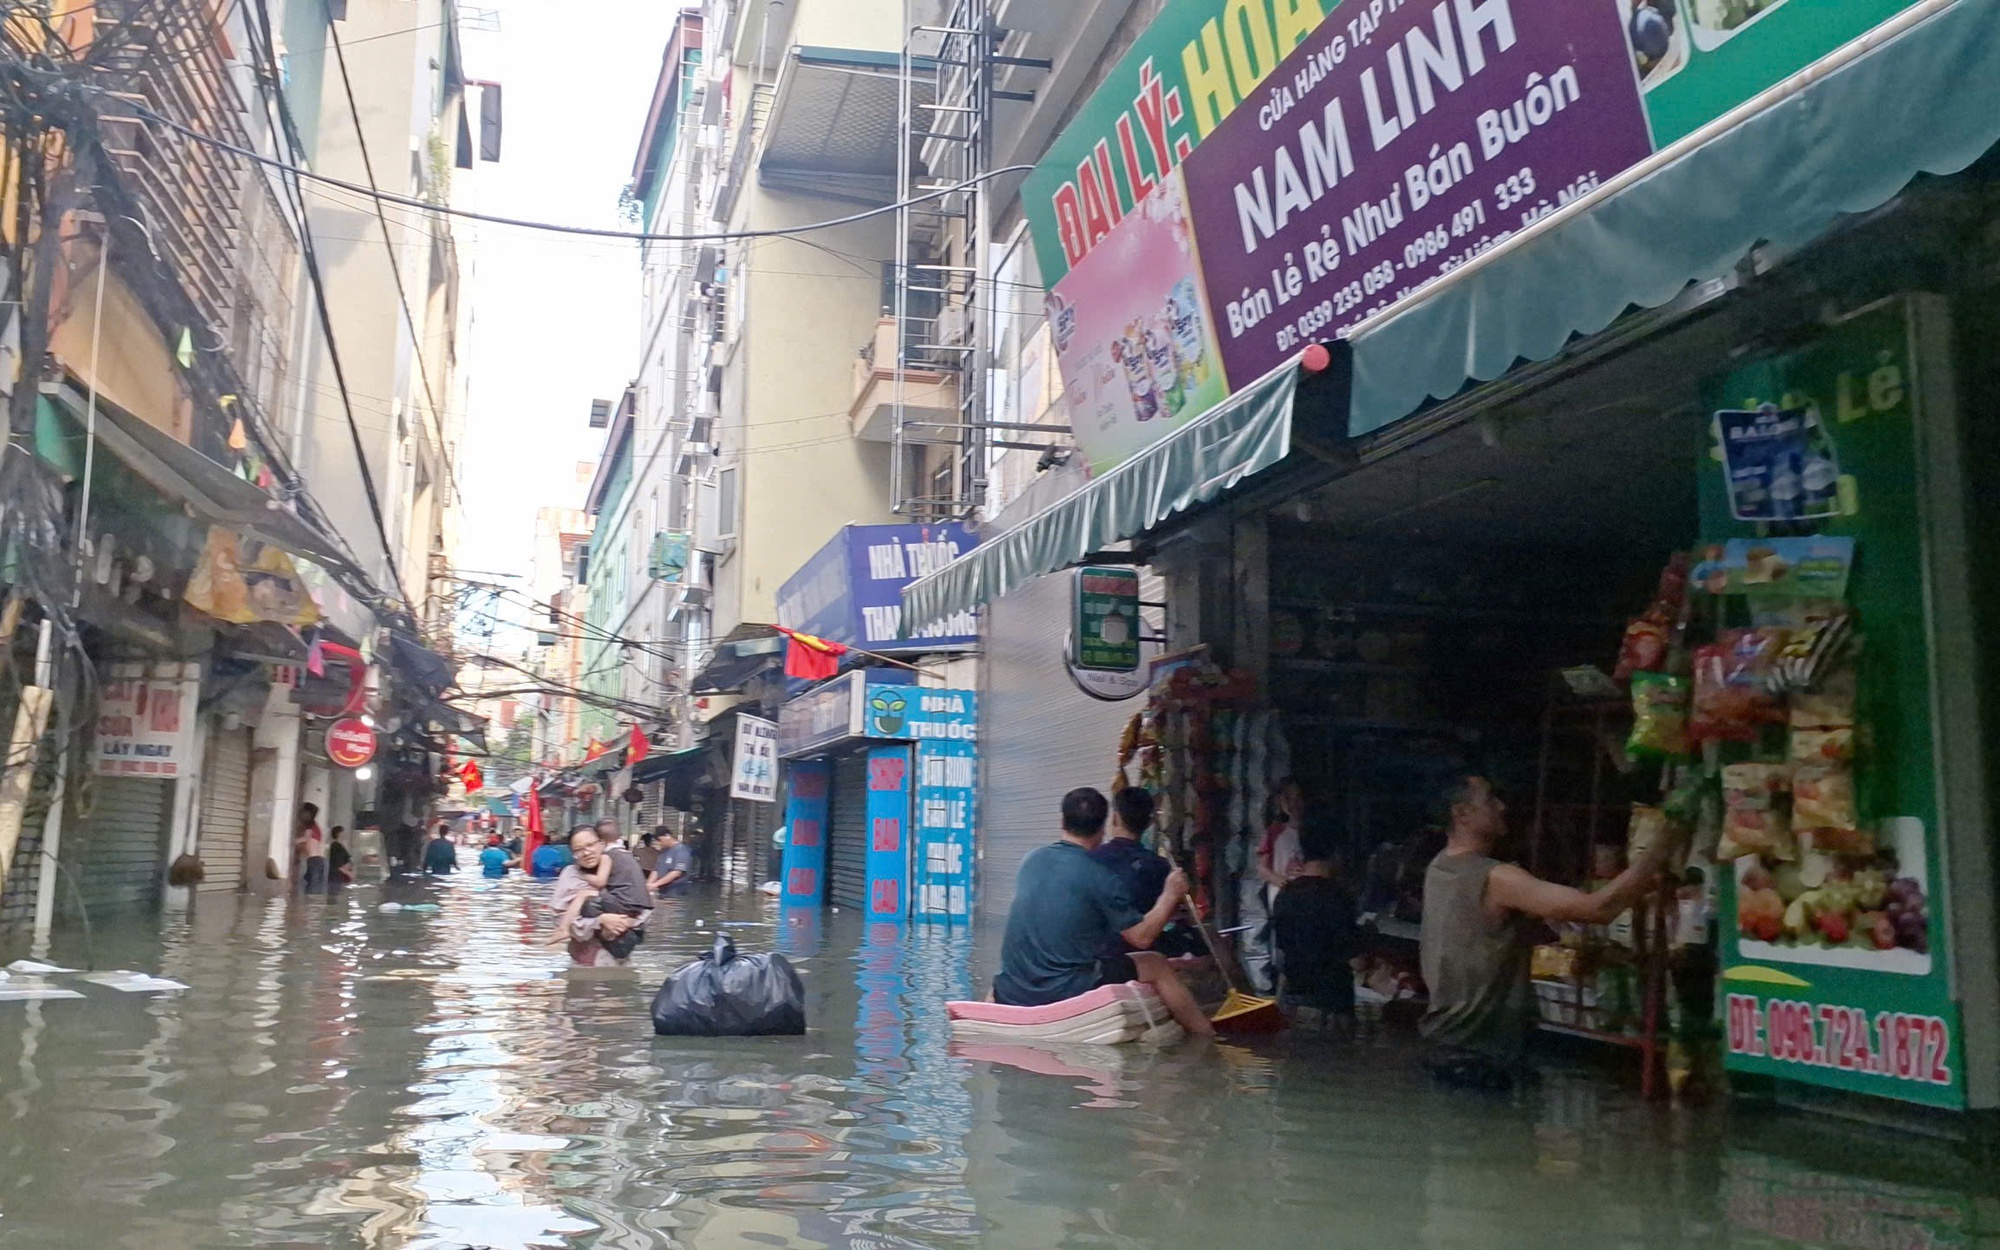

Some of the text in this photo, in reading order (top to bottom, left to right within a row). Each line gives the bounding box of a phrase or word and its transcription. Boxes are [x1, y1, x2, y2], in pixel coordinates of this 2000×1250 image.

[1258, 0, 1383, 131] CỬA HÀNG TẠP
[1234, 0, 1517, 254] NAM LINH
[1226, 286, 1273, 338] Bán
[1271, 252, 1304, 305] Lẻ
[1303, 224, 1341, 283] Rẻ
[1341, 182, 1404, 256] Như
[1404, 142, 1474, 212] Bán
[1476, 65, 1581, 162] Buôn
[1298, 300, 1333, 337] 0339
[1333, 281, 1363, 315] 233
[1362, 260, 1395, 295] 058
[1404, 223, 1449, 269] 0986
[1452, 199, 1485, 237] 491
[1494, 167, 1536, 210] 333
[868, 536, 906, 580] NHÀ
[907, 719, 977, 739] THUỐC
[920, 695, 965, 713] NHÀ
[1767, 998, 1952, 1086] 096.724.1872
